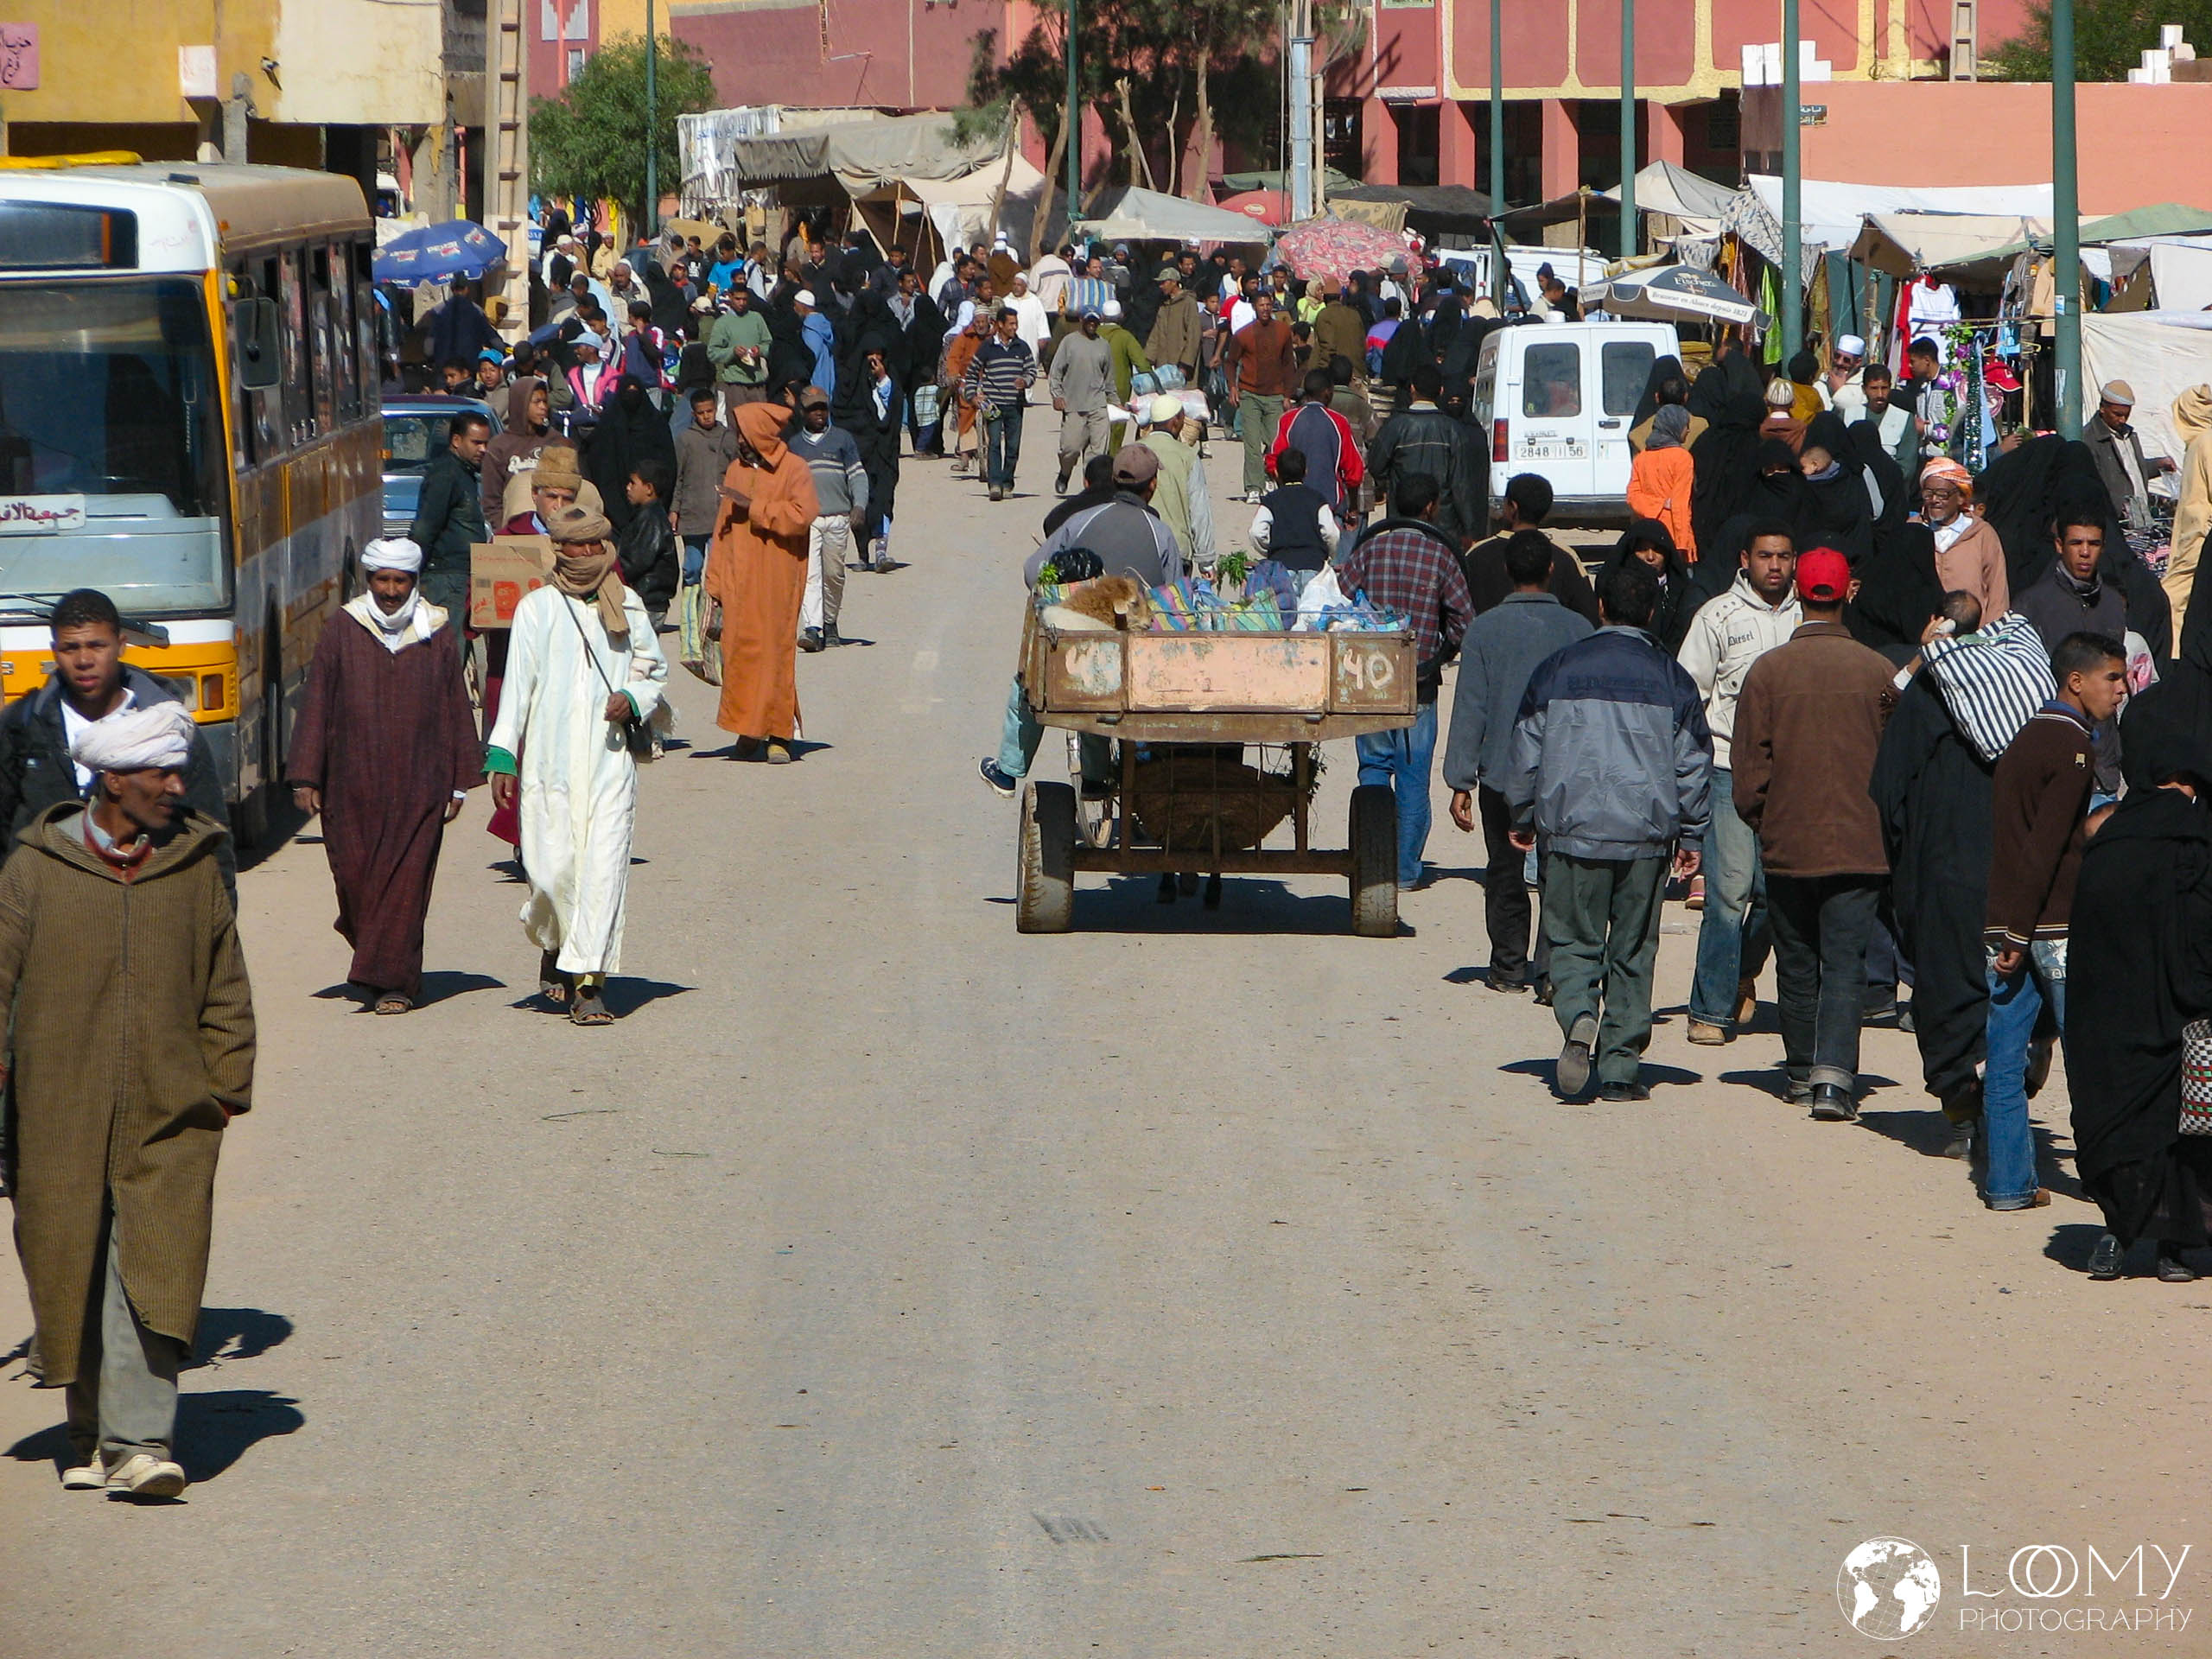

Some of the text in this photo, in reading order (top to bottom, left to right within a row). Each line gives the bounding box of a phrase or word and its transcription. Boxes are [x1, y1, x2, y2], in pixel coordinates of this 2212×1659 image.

[1520, 446, 1549, 458] 2848
[1568, 445, 1583, 457] 56
[1343, 649, 1395, 690] 40
